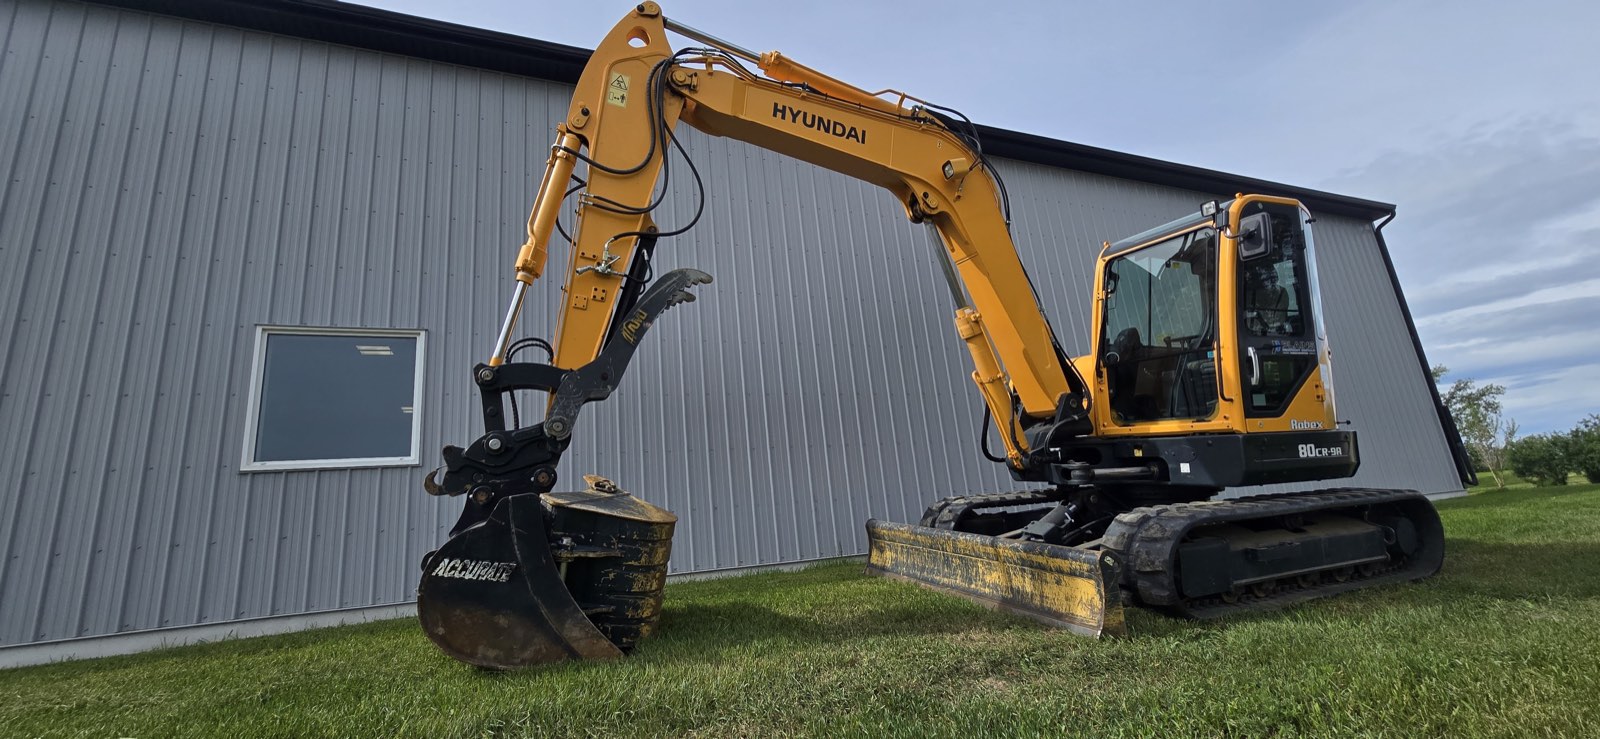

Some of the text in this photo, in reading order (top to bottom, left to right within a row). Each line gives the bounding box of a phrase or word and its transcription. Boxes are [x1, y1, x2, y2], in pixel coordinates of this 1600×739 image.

[772, 102, 867, 145] HYUNDAI
[1290, 419, 1323, 430] Robex
[1298, 443, 1343, 458] 80CR-9A
[431, 558, 517, 582] ACCURATE
